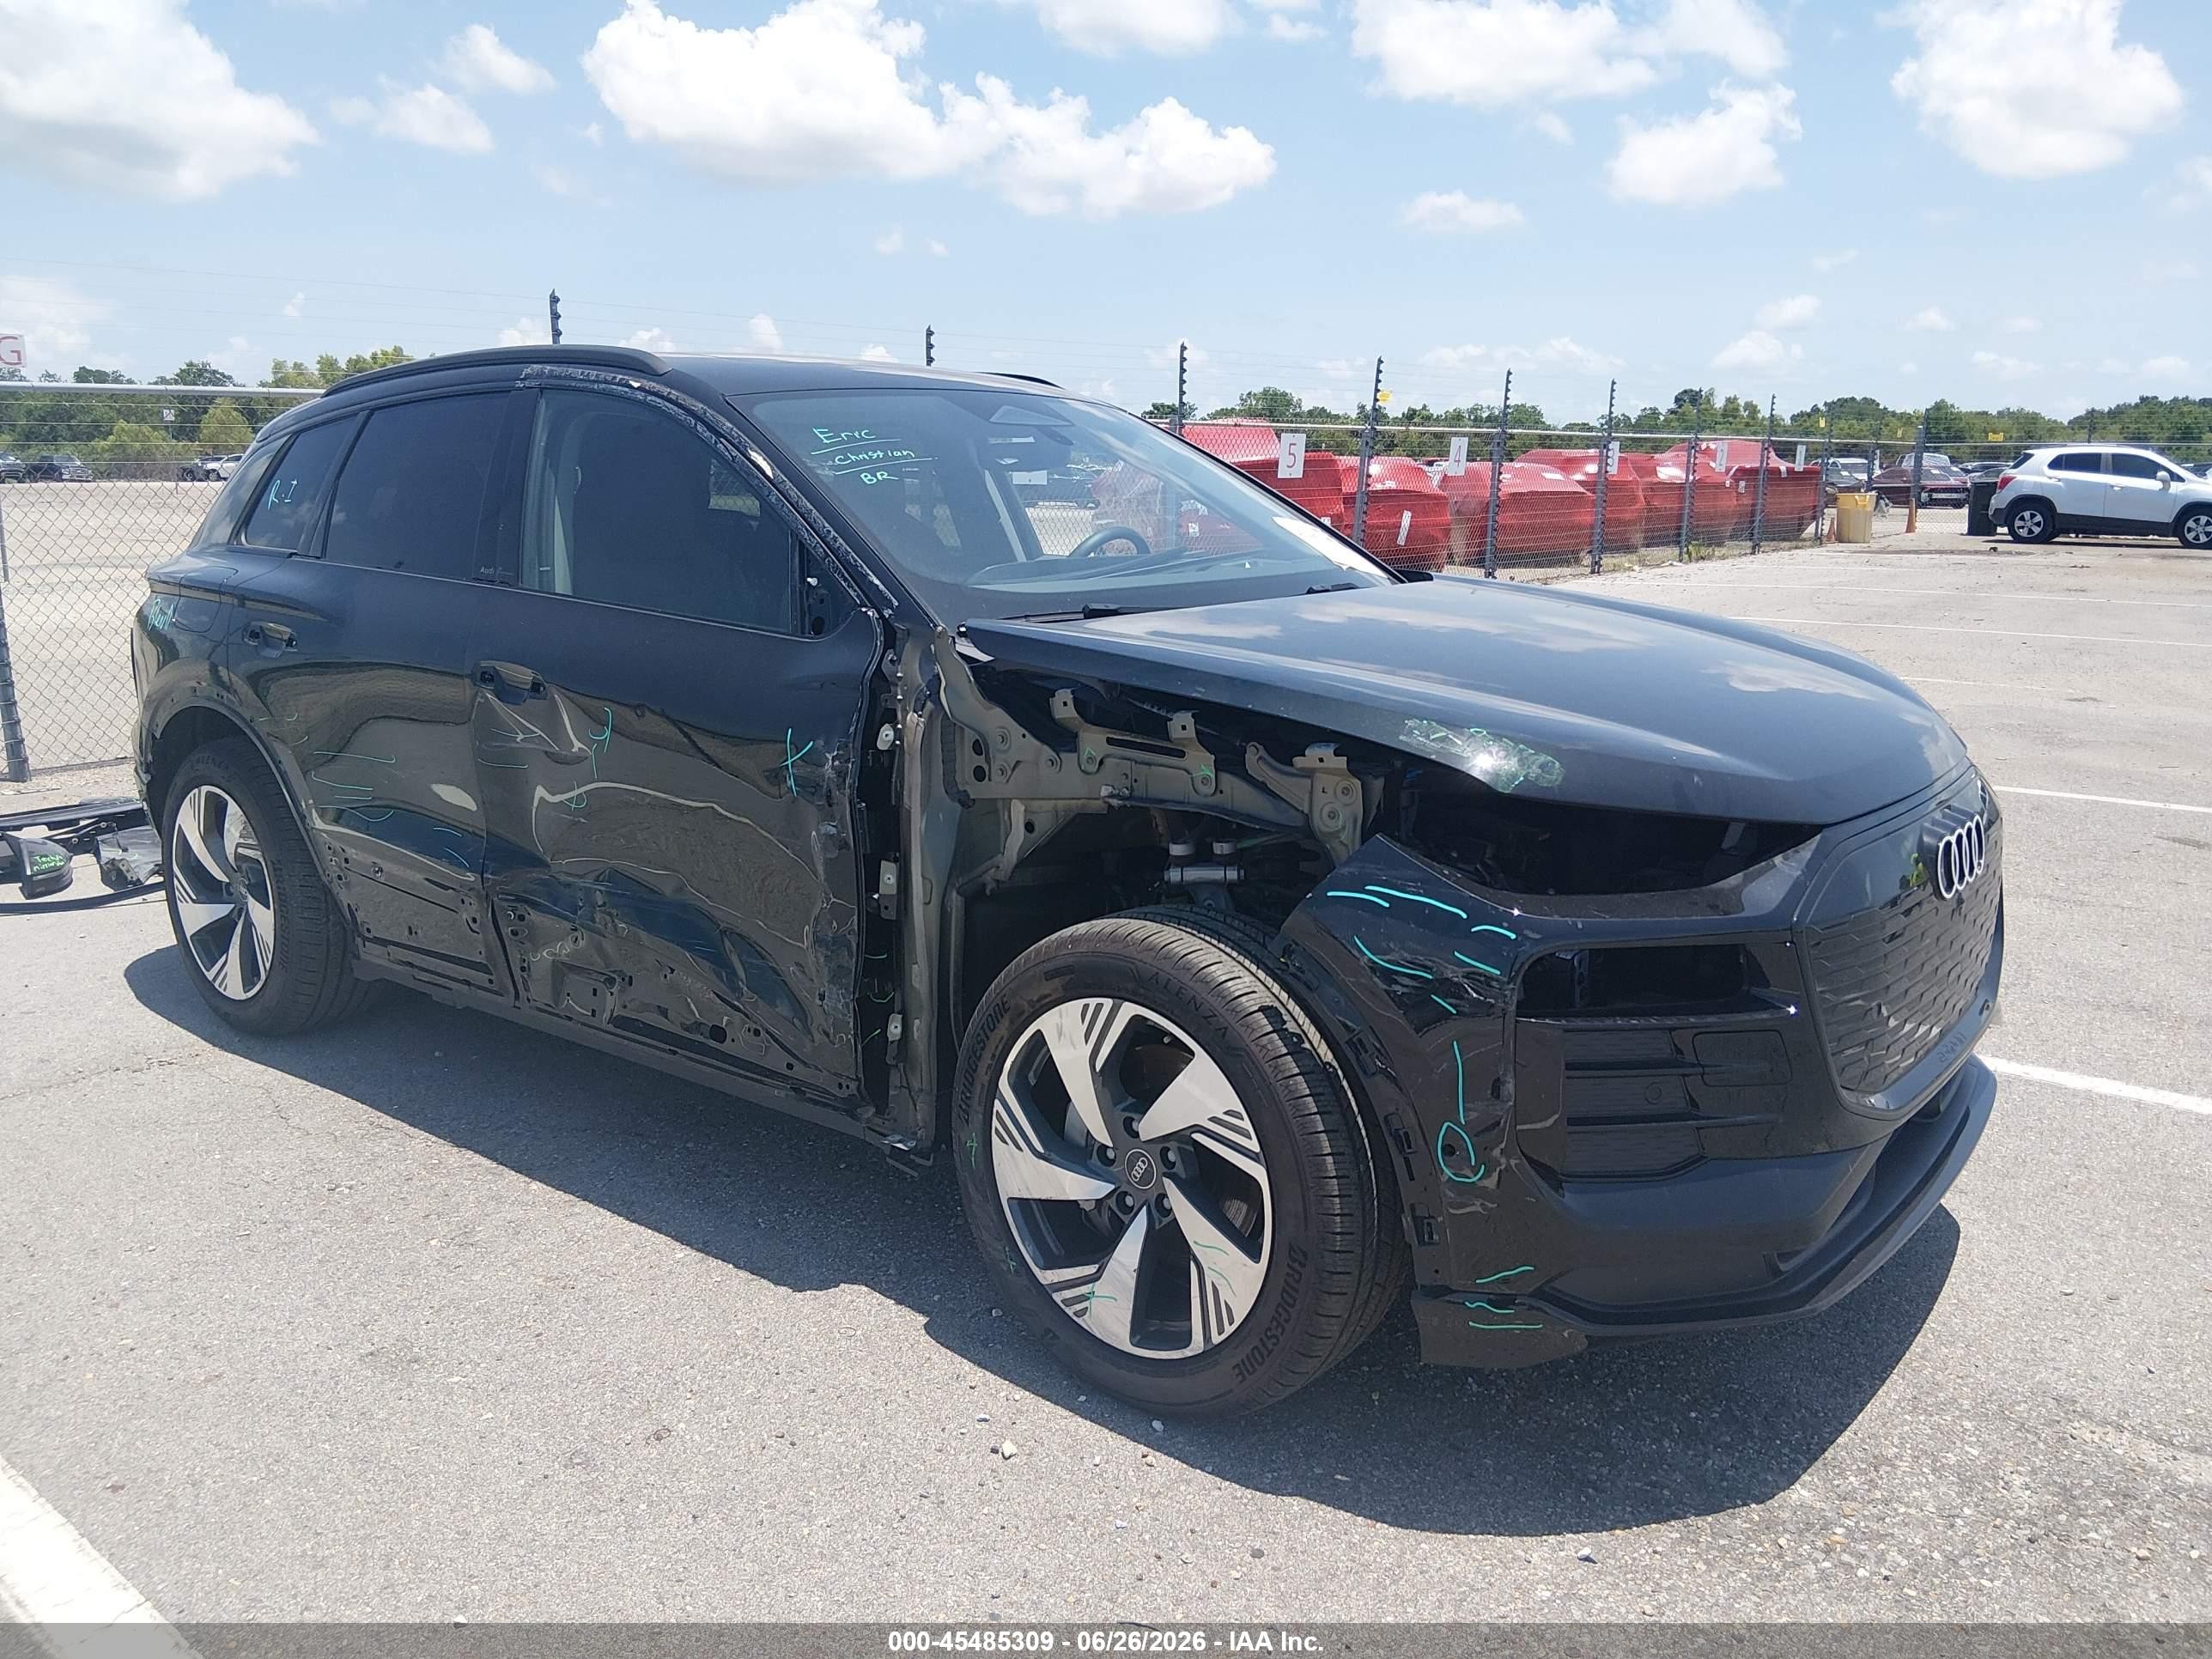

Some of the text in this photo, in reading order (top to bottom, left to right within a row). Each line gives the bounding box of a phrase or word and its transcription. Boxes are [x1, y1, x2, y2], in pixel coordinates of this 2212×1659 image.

[0, 335, 22, 366] G
[812, 428, 877, 444] Eric
[1286, 442, 1297, 468] 5
[1454, 445, 1462, 468] 4
[1718, 448, 1724, 466] 2
[860, 471, 900, 484] BR
[1147, 971, 1229, 1040] ALENZA
[958, 994, 1012, 1127] BRIDGESTONE
[1232, 1242, 1307, 1384] BRIDGESTONE
